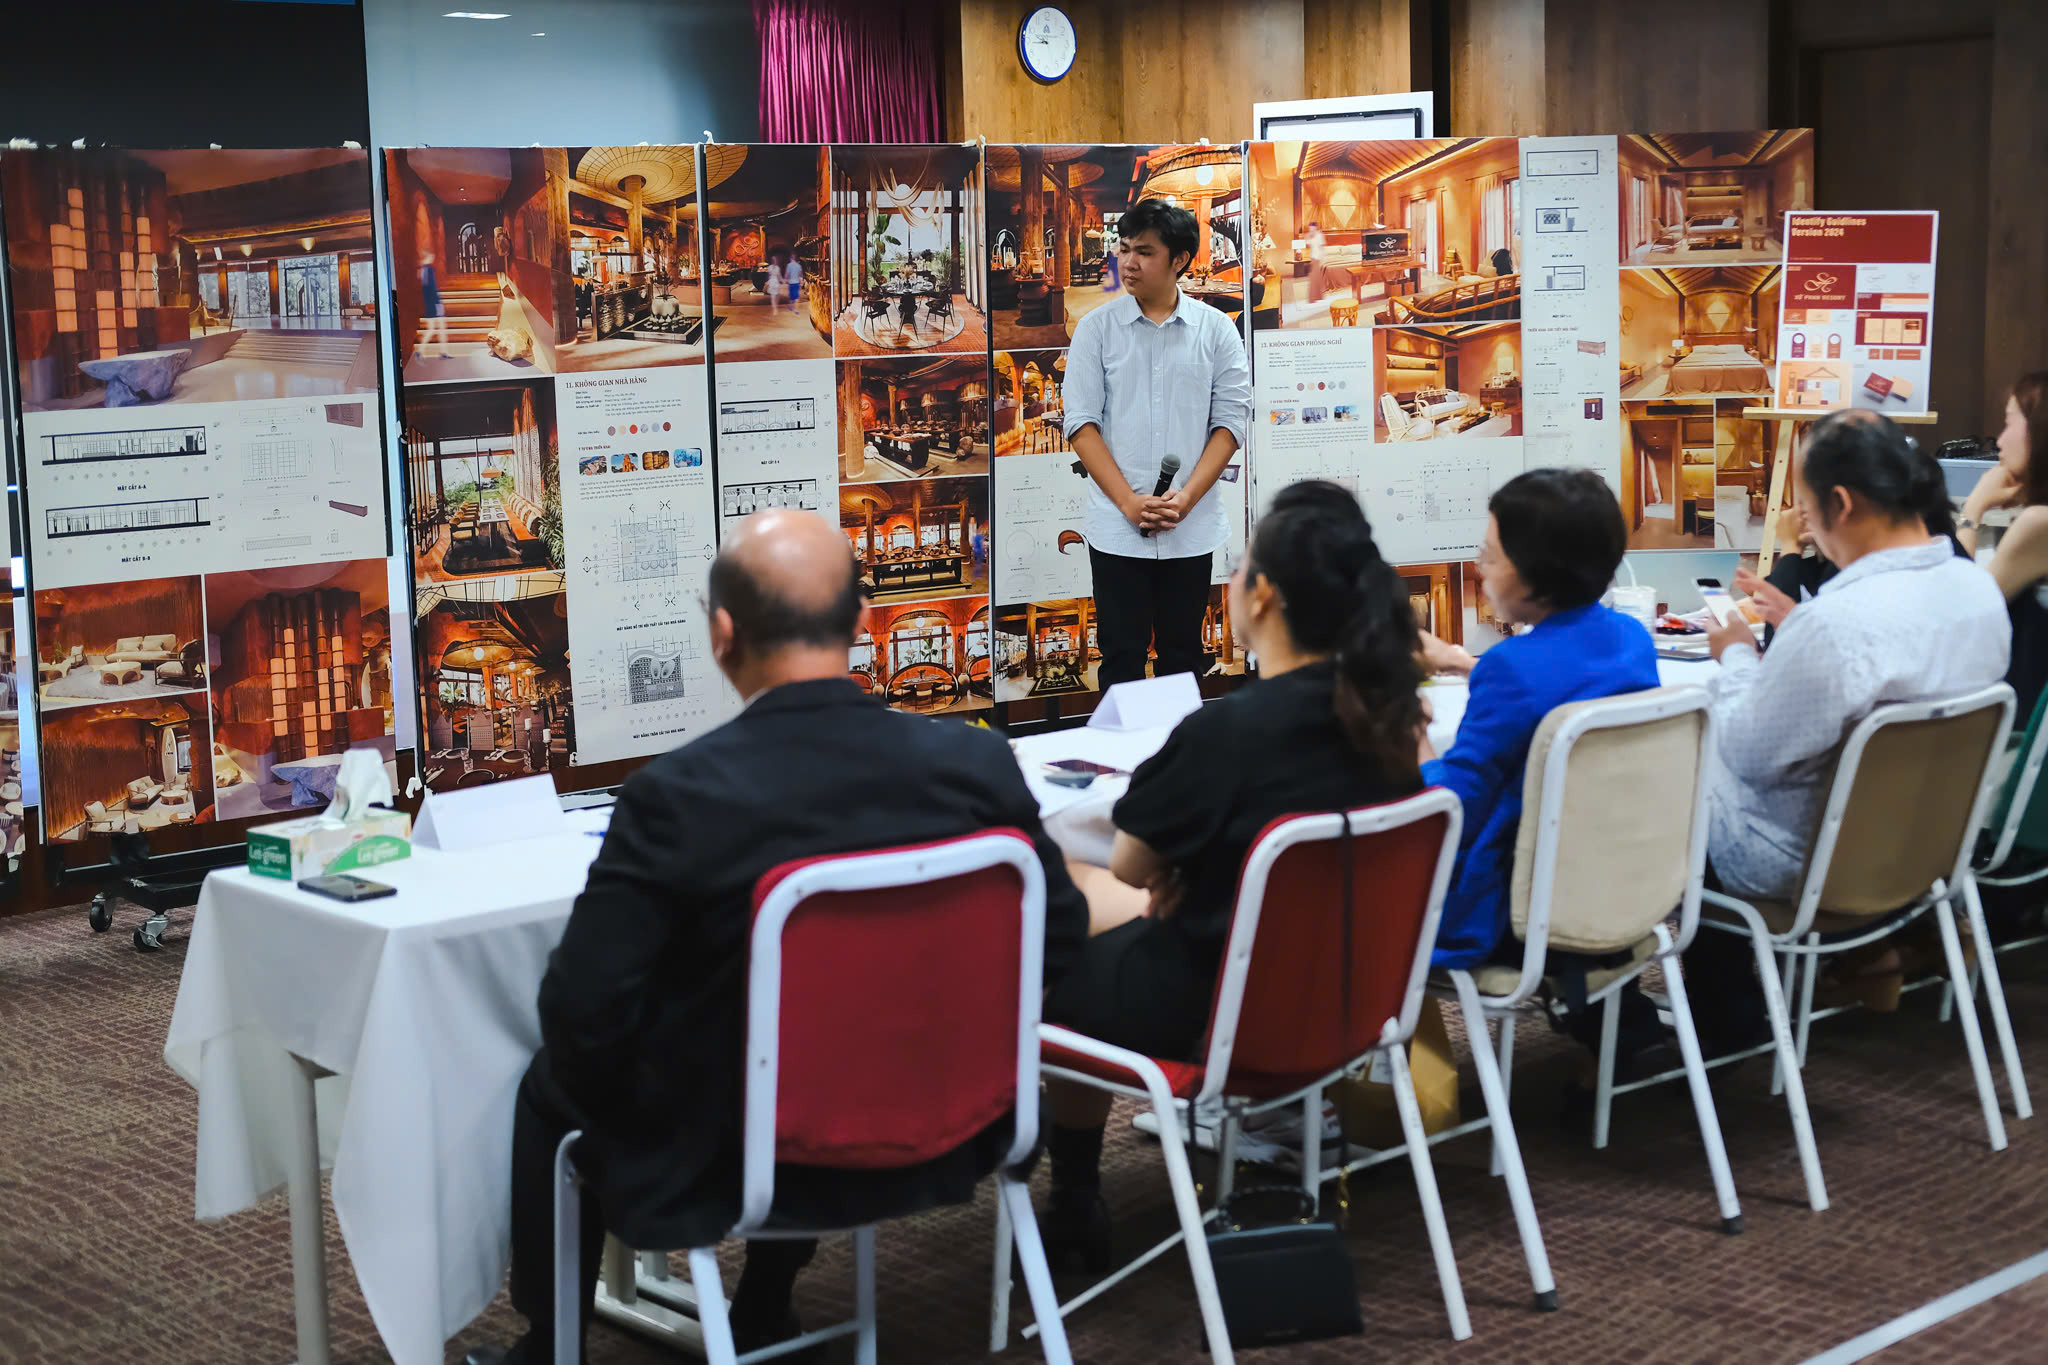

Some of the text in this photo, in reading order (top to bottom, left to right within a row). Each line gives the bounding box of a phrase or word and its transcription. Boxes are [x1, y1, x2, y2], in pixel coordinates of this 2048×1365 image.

[1792, 217, 1825, 227] Identify
[1792, 228, 1844, 236] Version 2024
[575, 380, 597, 388] KHÔNG
[615, 377, 628, 385] NHÀ
[630, 376, 647, 384] HÀNG
